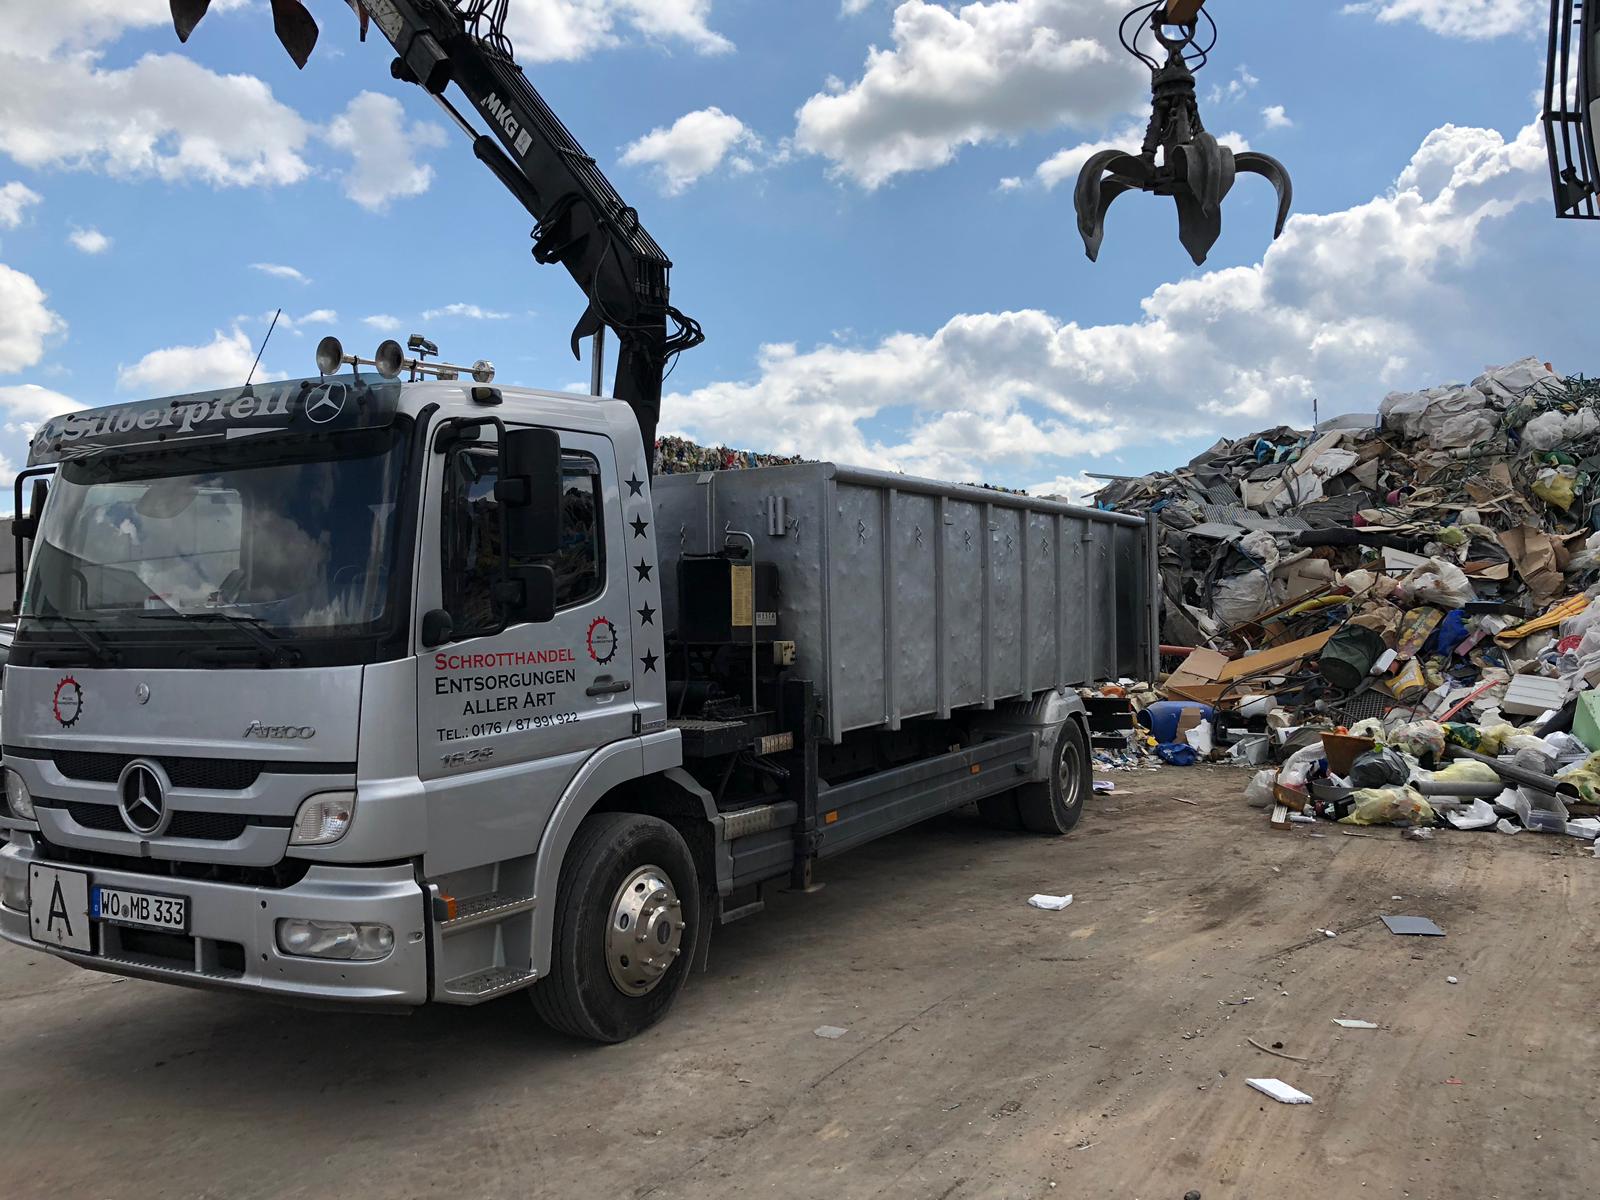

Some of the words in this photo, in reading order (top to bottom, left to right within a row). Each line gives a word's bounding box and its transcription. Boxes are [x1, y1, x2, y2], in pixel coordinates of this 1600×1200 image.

[480, 92, 519, 139] MKG
[60, 386, 294, 441] Silberpfeil
[435, 649, 575, 671] SCHROTTHANDEL
[435, 669, 576, 695] ENTSORGUNGEN
[463, 696, 518, 716] ALLER
[523, 691, 556, 709] ART
[437, 727, 469, 742] TEL.:
[471, 721, 502, 737] 0176
[515, 718, 531, 731] 87
[533, 715, 554, 728] 991
[557, 711, 580, 725] 922
[47, 880, 73, 937] A
[101, 891, 120, 916] WO
[130, 895, 150, 920] MB
[153, 899, 184, 926] 333
